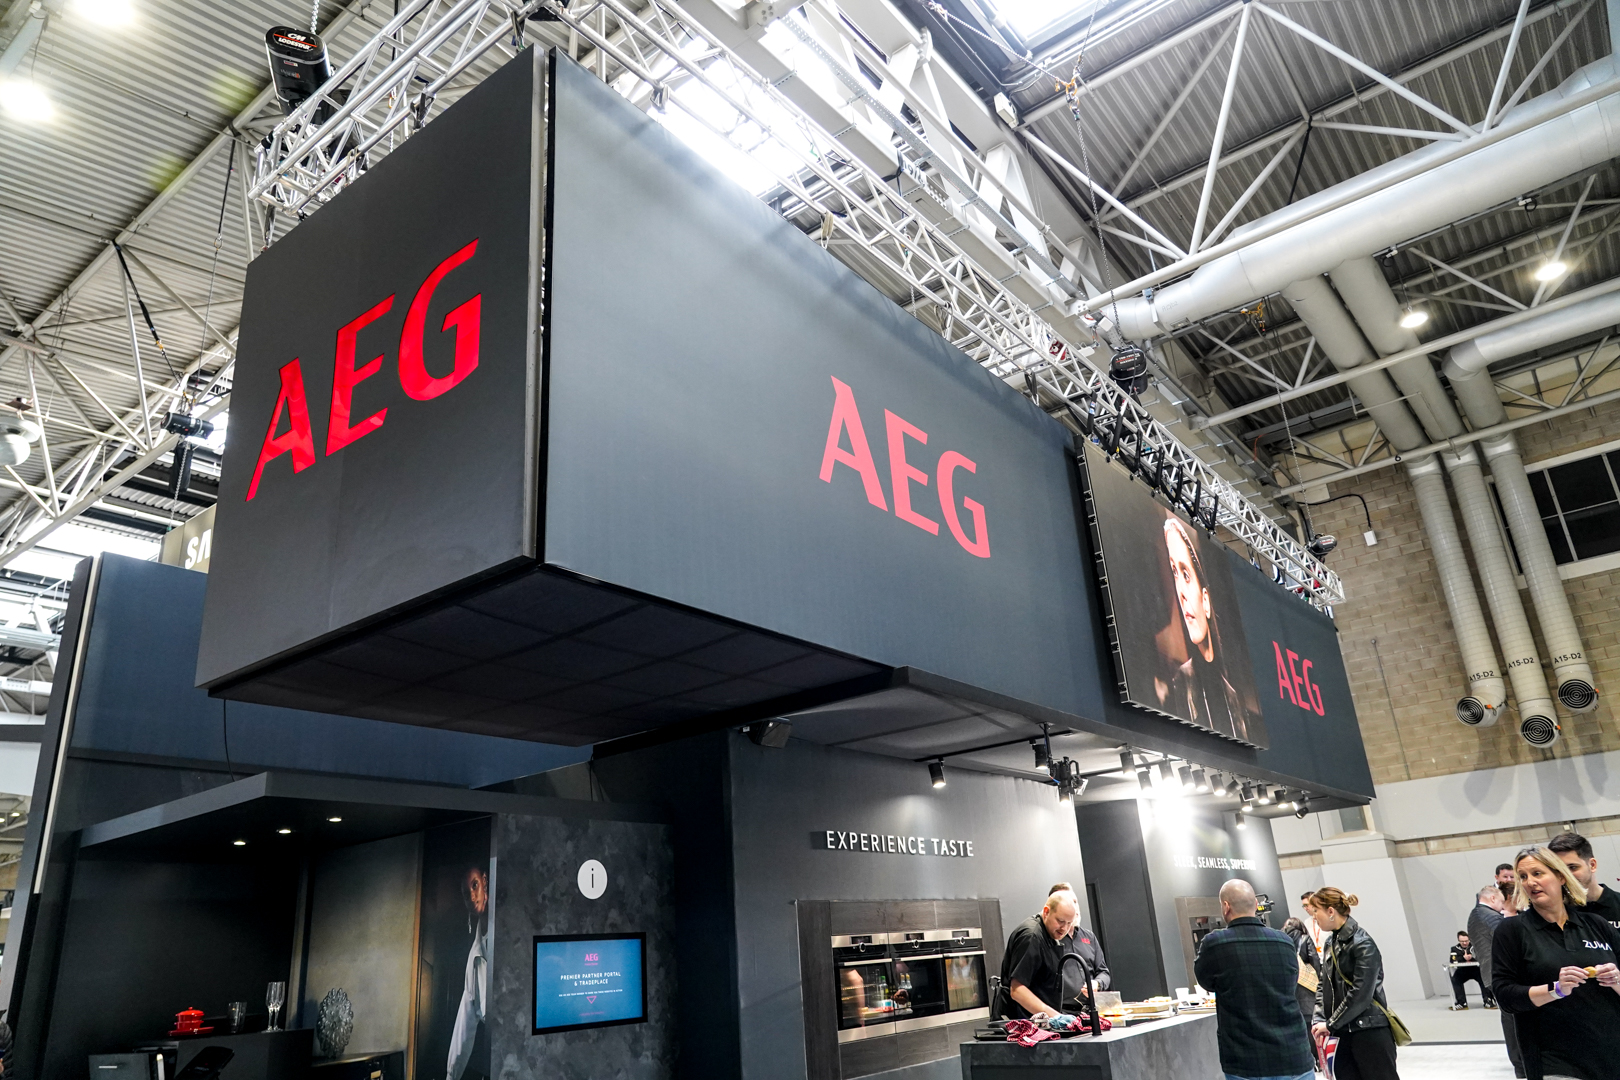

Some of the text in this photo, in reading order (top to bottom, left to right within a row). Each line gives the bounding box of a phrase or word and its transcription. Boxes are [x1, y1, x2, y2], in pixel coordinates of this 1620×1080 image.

[246, 238, 482, 502] AEG
[819, 375, 990, 558] AEG
[1508, 657, 1535, 669] A15-D2
[1554, 652, 1582, 664] A15-D2
[1272, 640, 1325, 717] AEG
[1468, 670, 1495, 682] A15-D2
[826, 830, 975, 857] EXPERIENCE TASTE
[1198, 857, 1230, 870] SEAMLESS,
[584, 953, 599, 962] AEG
